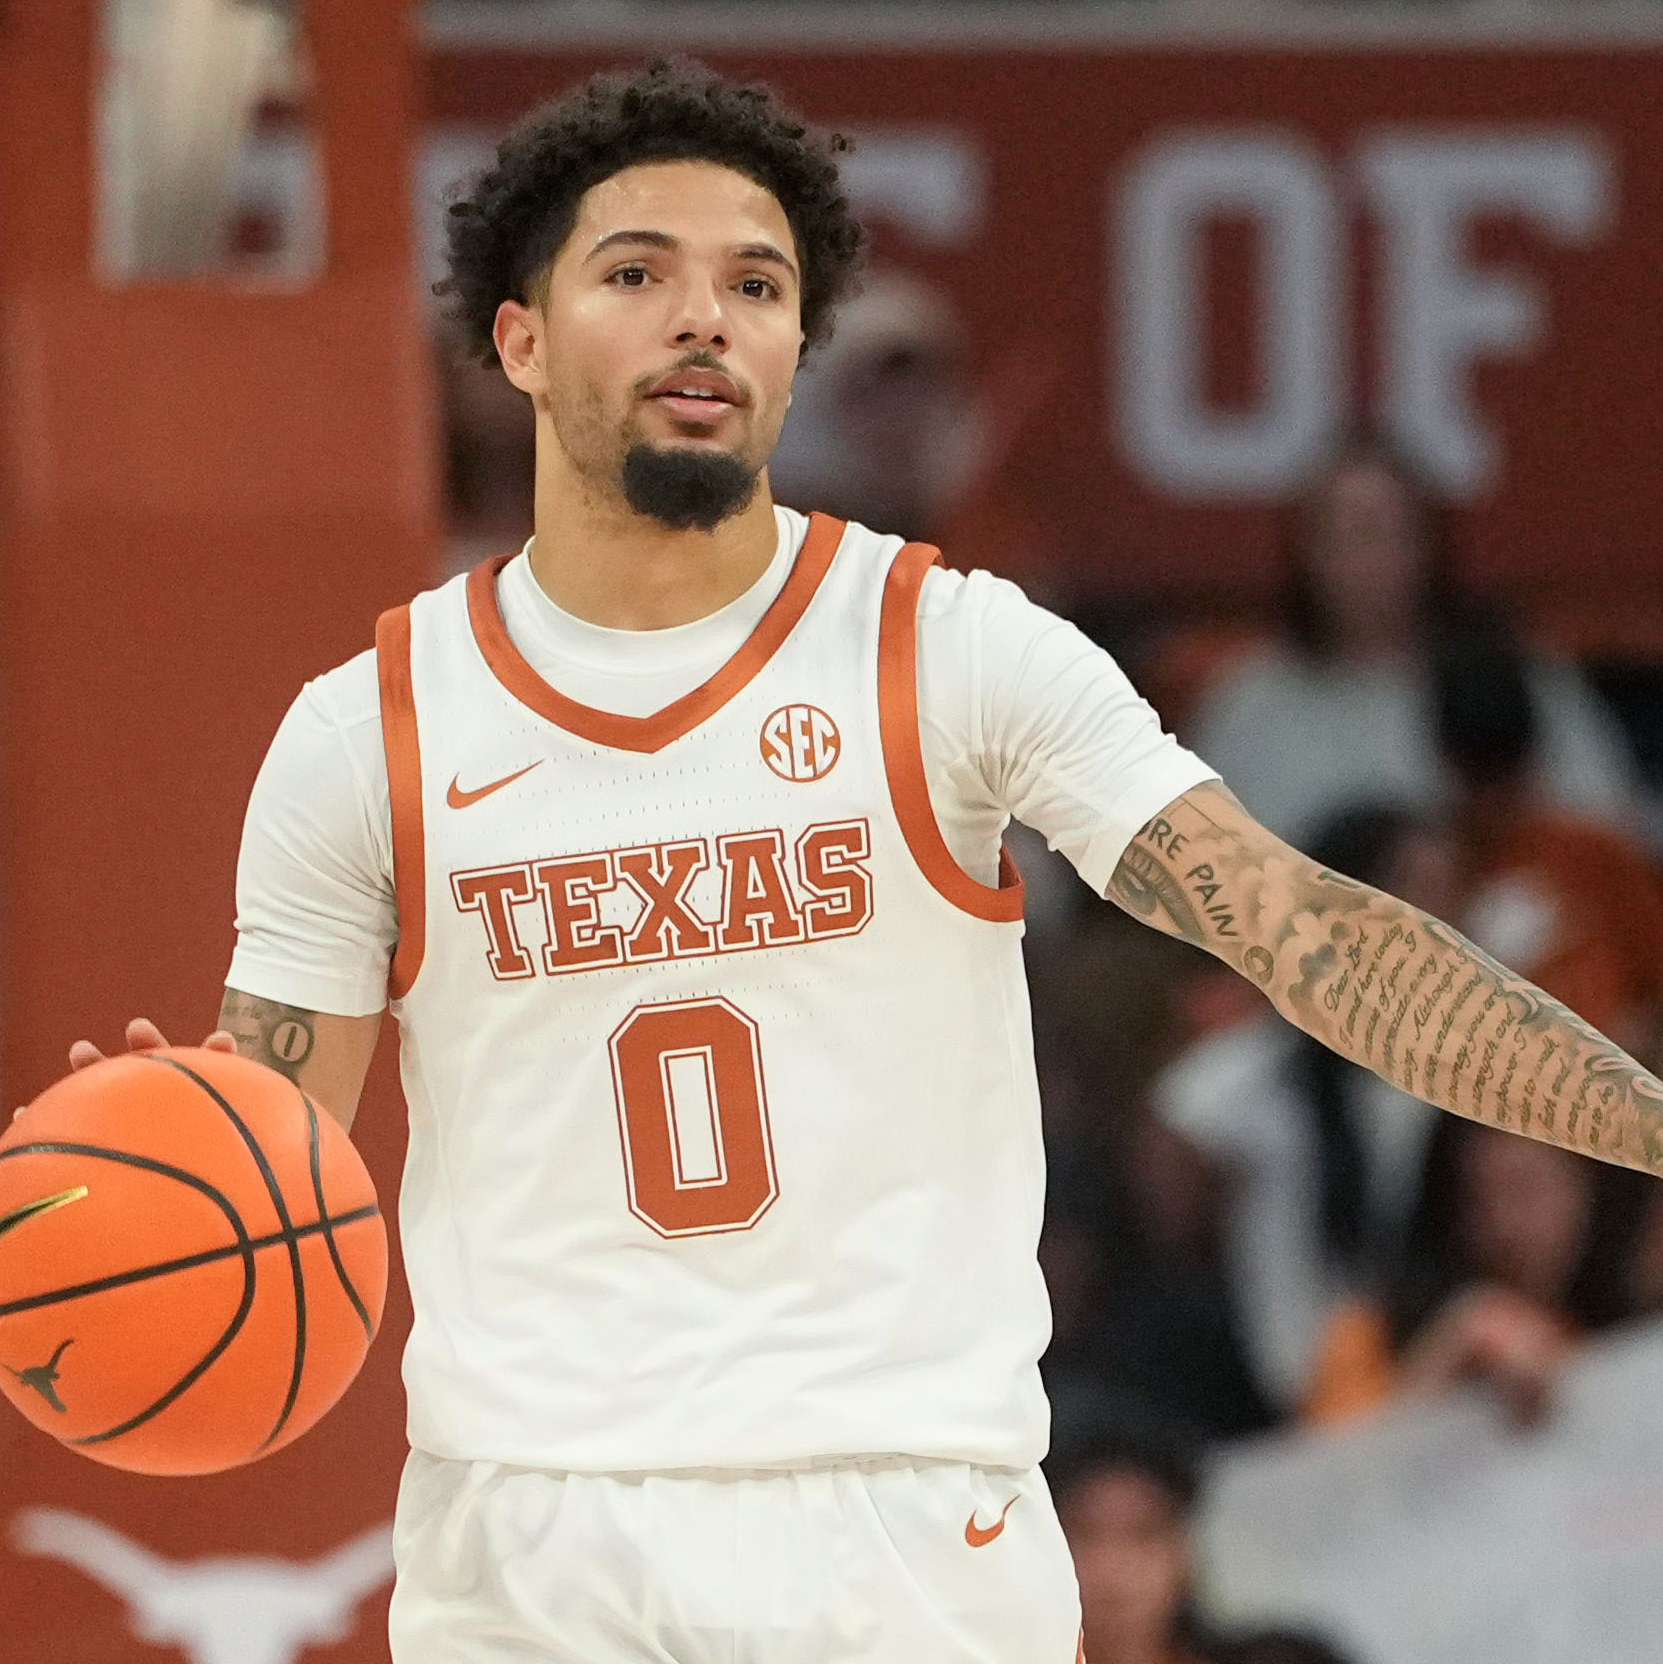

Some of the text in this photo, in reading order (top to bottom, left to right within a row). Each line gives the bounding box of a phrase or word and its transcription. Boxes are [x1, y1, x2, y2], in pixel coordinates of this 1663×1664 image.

[1114, 128, 1608, 498] OF
[765, 705, 838, 781] SEC
[450, 818, 874, 981] TEXAS
[1138, 818, 1238, 936] RE PAIN
[1323, 926, 1368, 1010] Dear Lord
[1413, 961, 1458, 1040] Although
[1495, 1002, 1514, 1038] and
[607, 996, 780, 1239] 0
